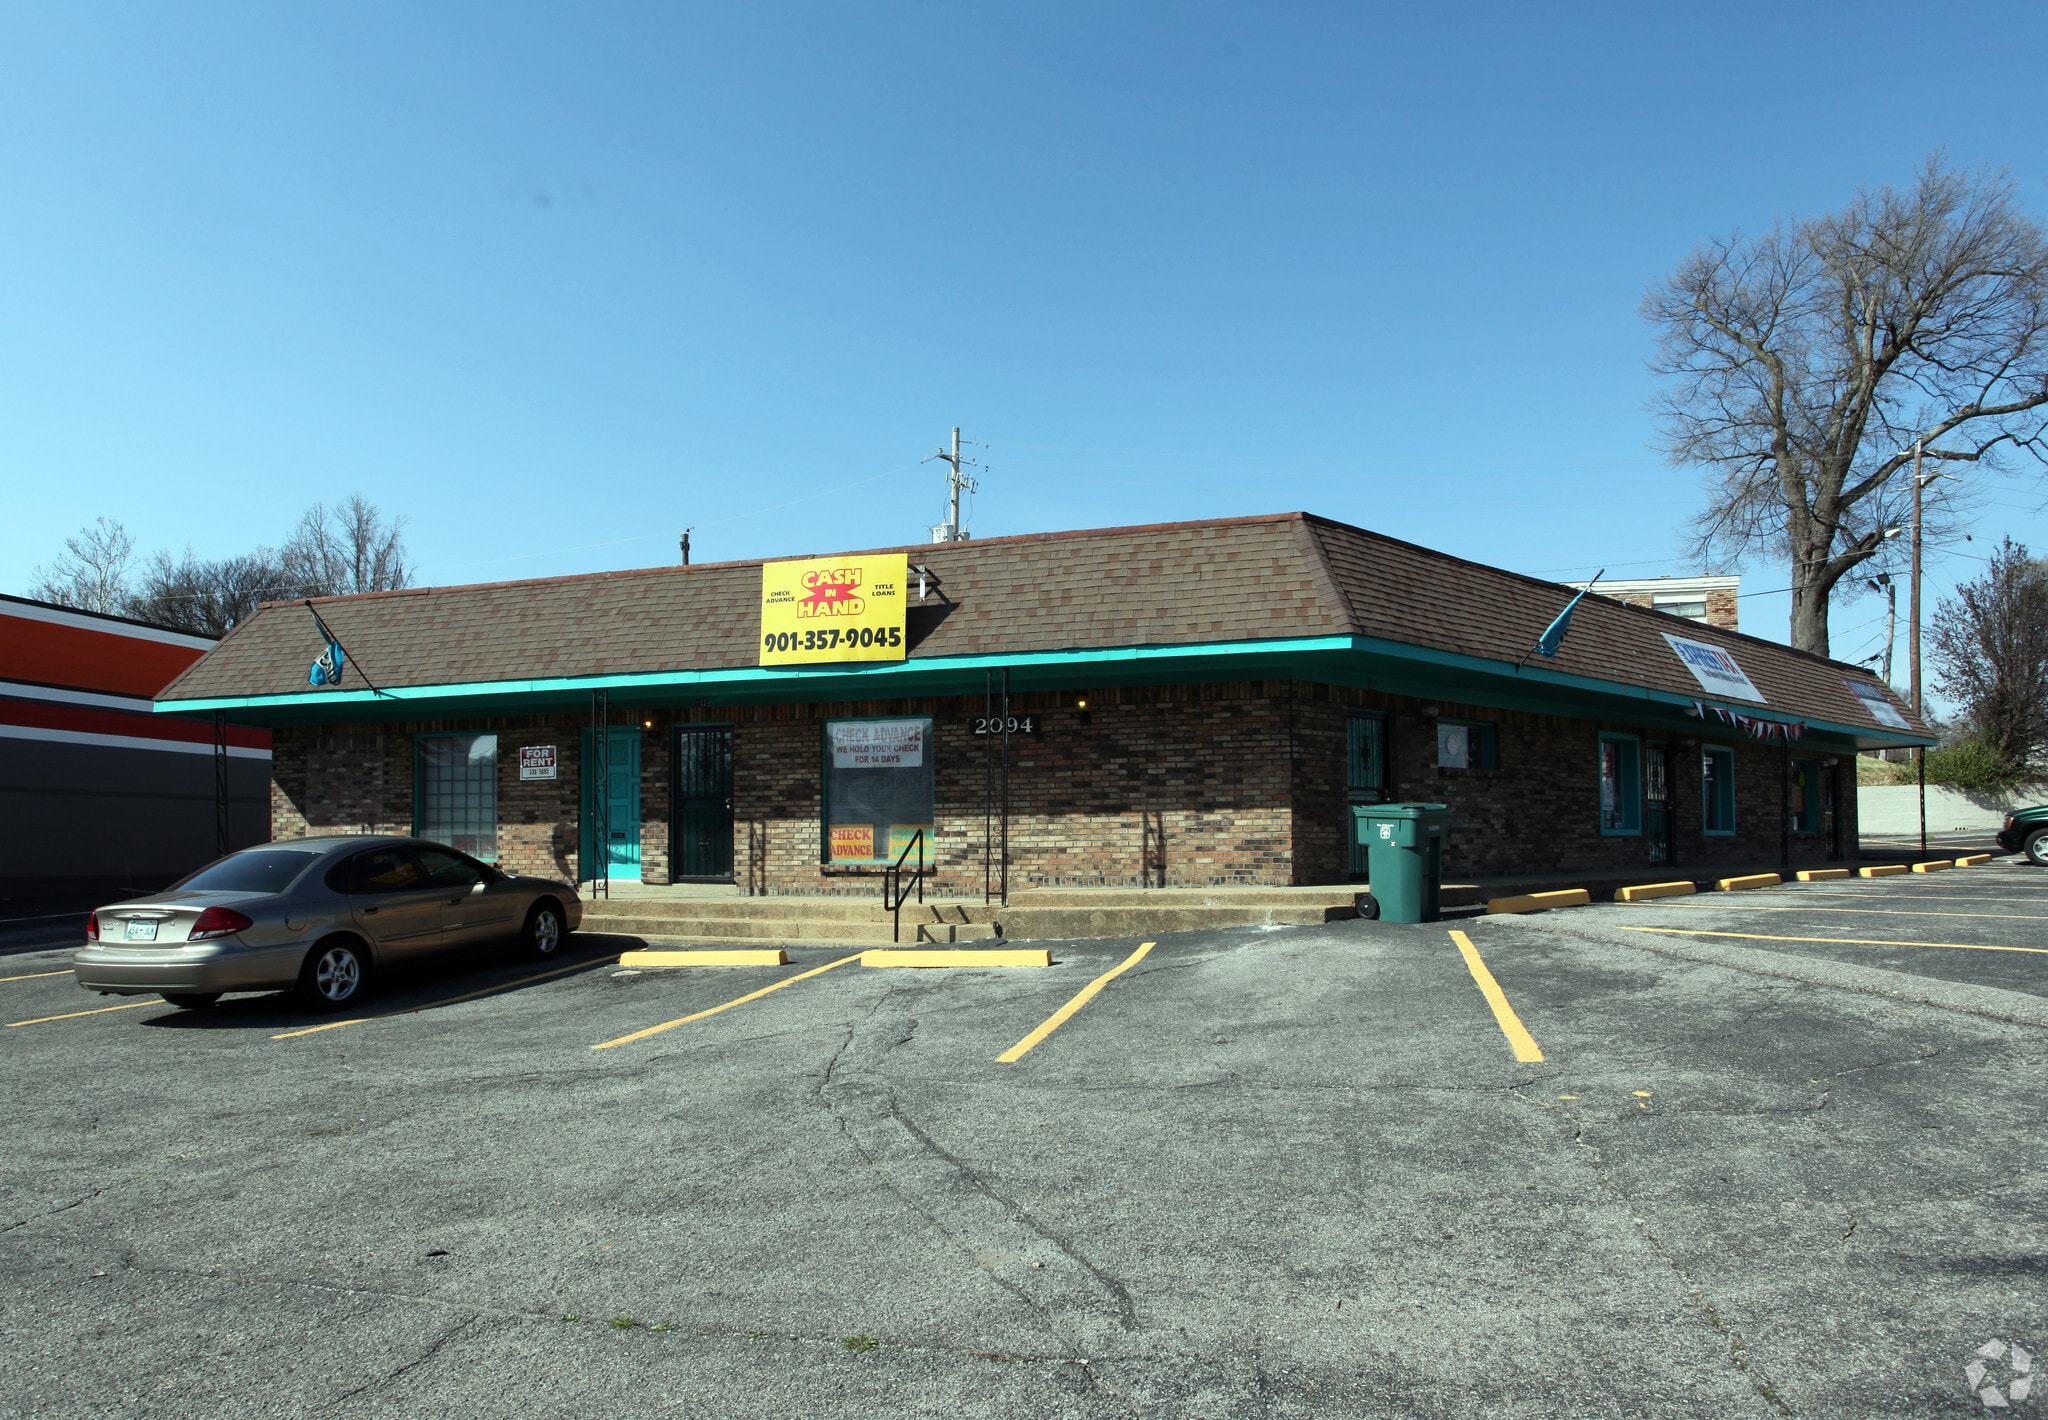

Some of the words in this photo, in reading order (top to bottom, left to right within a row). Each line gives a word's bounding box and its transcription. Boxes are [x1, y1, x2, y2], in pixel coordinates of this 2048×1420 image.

[801, 568, 862, 588] CASH
[825, 589, 836, 597] IN
[797, 598, 865, 618] HAND
[765, 627, 901, 652] 901-357-9045
[975, 716, 1033, 734] 2094
[835, 727, 869, 743] CHECK
[873, 725, 920, 742] ADVANCE
[526, 749, 549, 758] FOR
[850, 745, 869, 753] HOLD
[872, 744, 891, 752] YOUR
[894, 744, 919, 752] CHECK
[523, 758, 553, 767] RENT
[881, 755, 900, 763] DAYS
[830, 829, 871, 840] CHECK
[830, 845, 872, 856] ADVANCE
